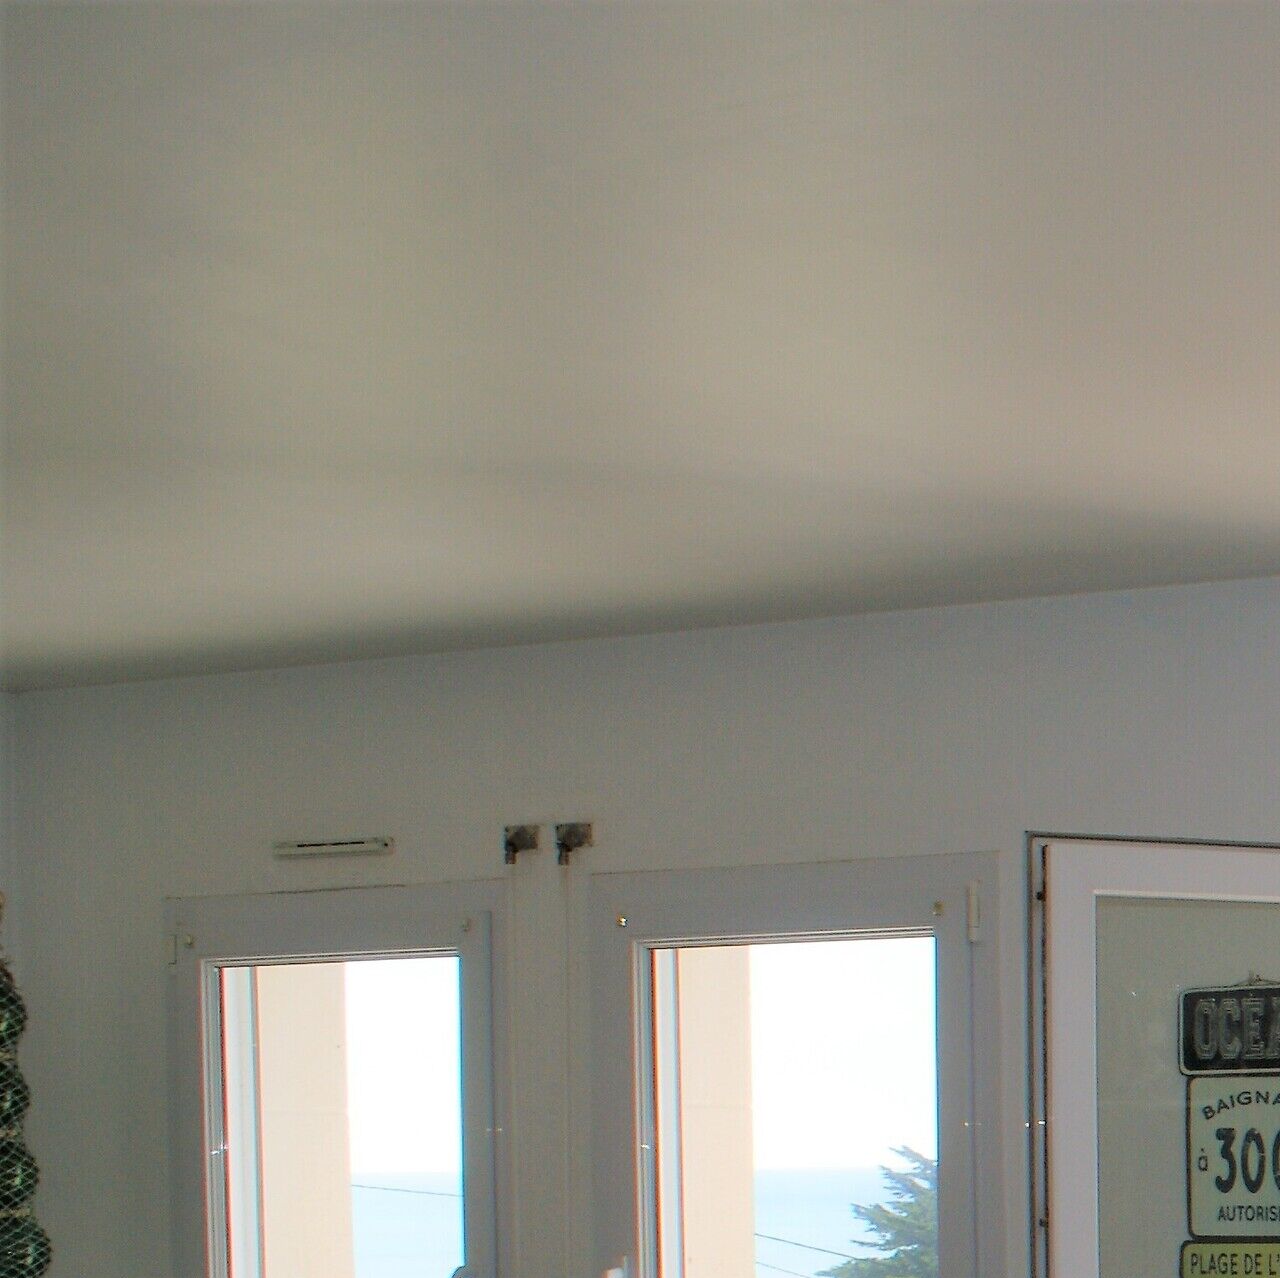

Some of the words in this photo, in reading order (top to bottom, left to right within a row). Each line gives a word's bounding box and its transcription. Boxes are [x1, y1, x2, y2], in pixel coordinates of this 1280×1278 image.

[1197, 1148, 1209, 1173] à
[1190, 1252, 1239, 1276] PLAGE
[1243, 1252, 1263, 1276] DE
